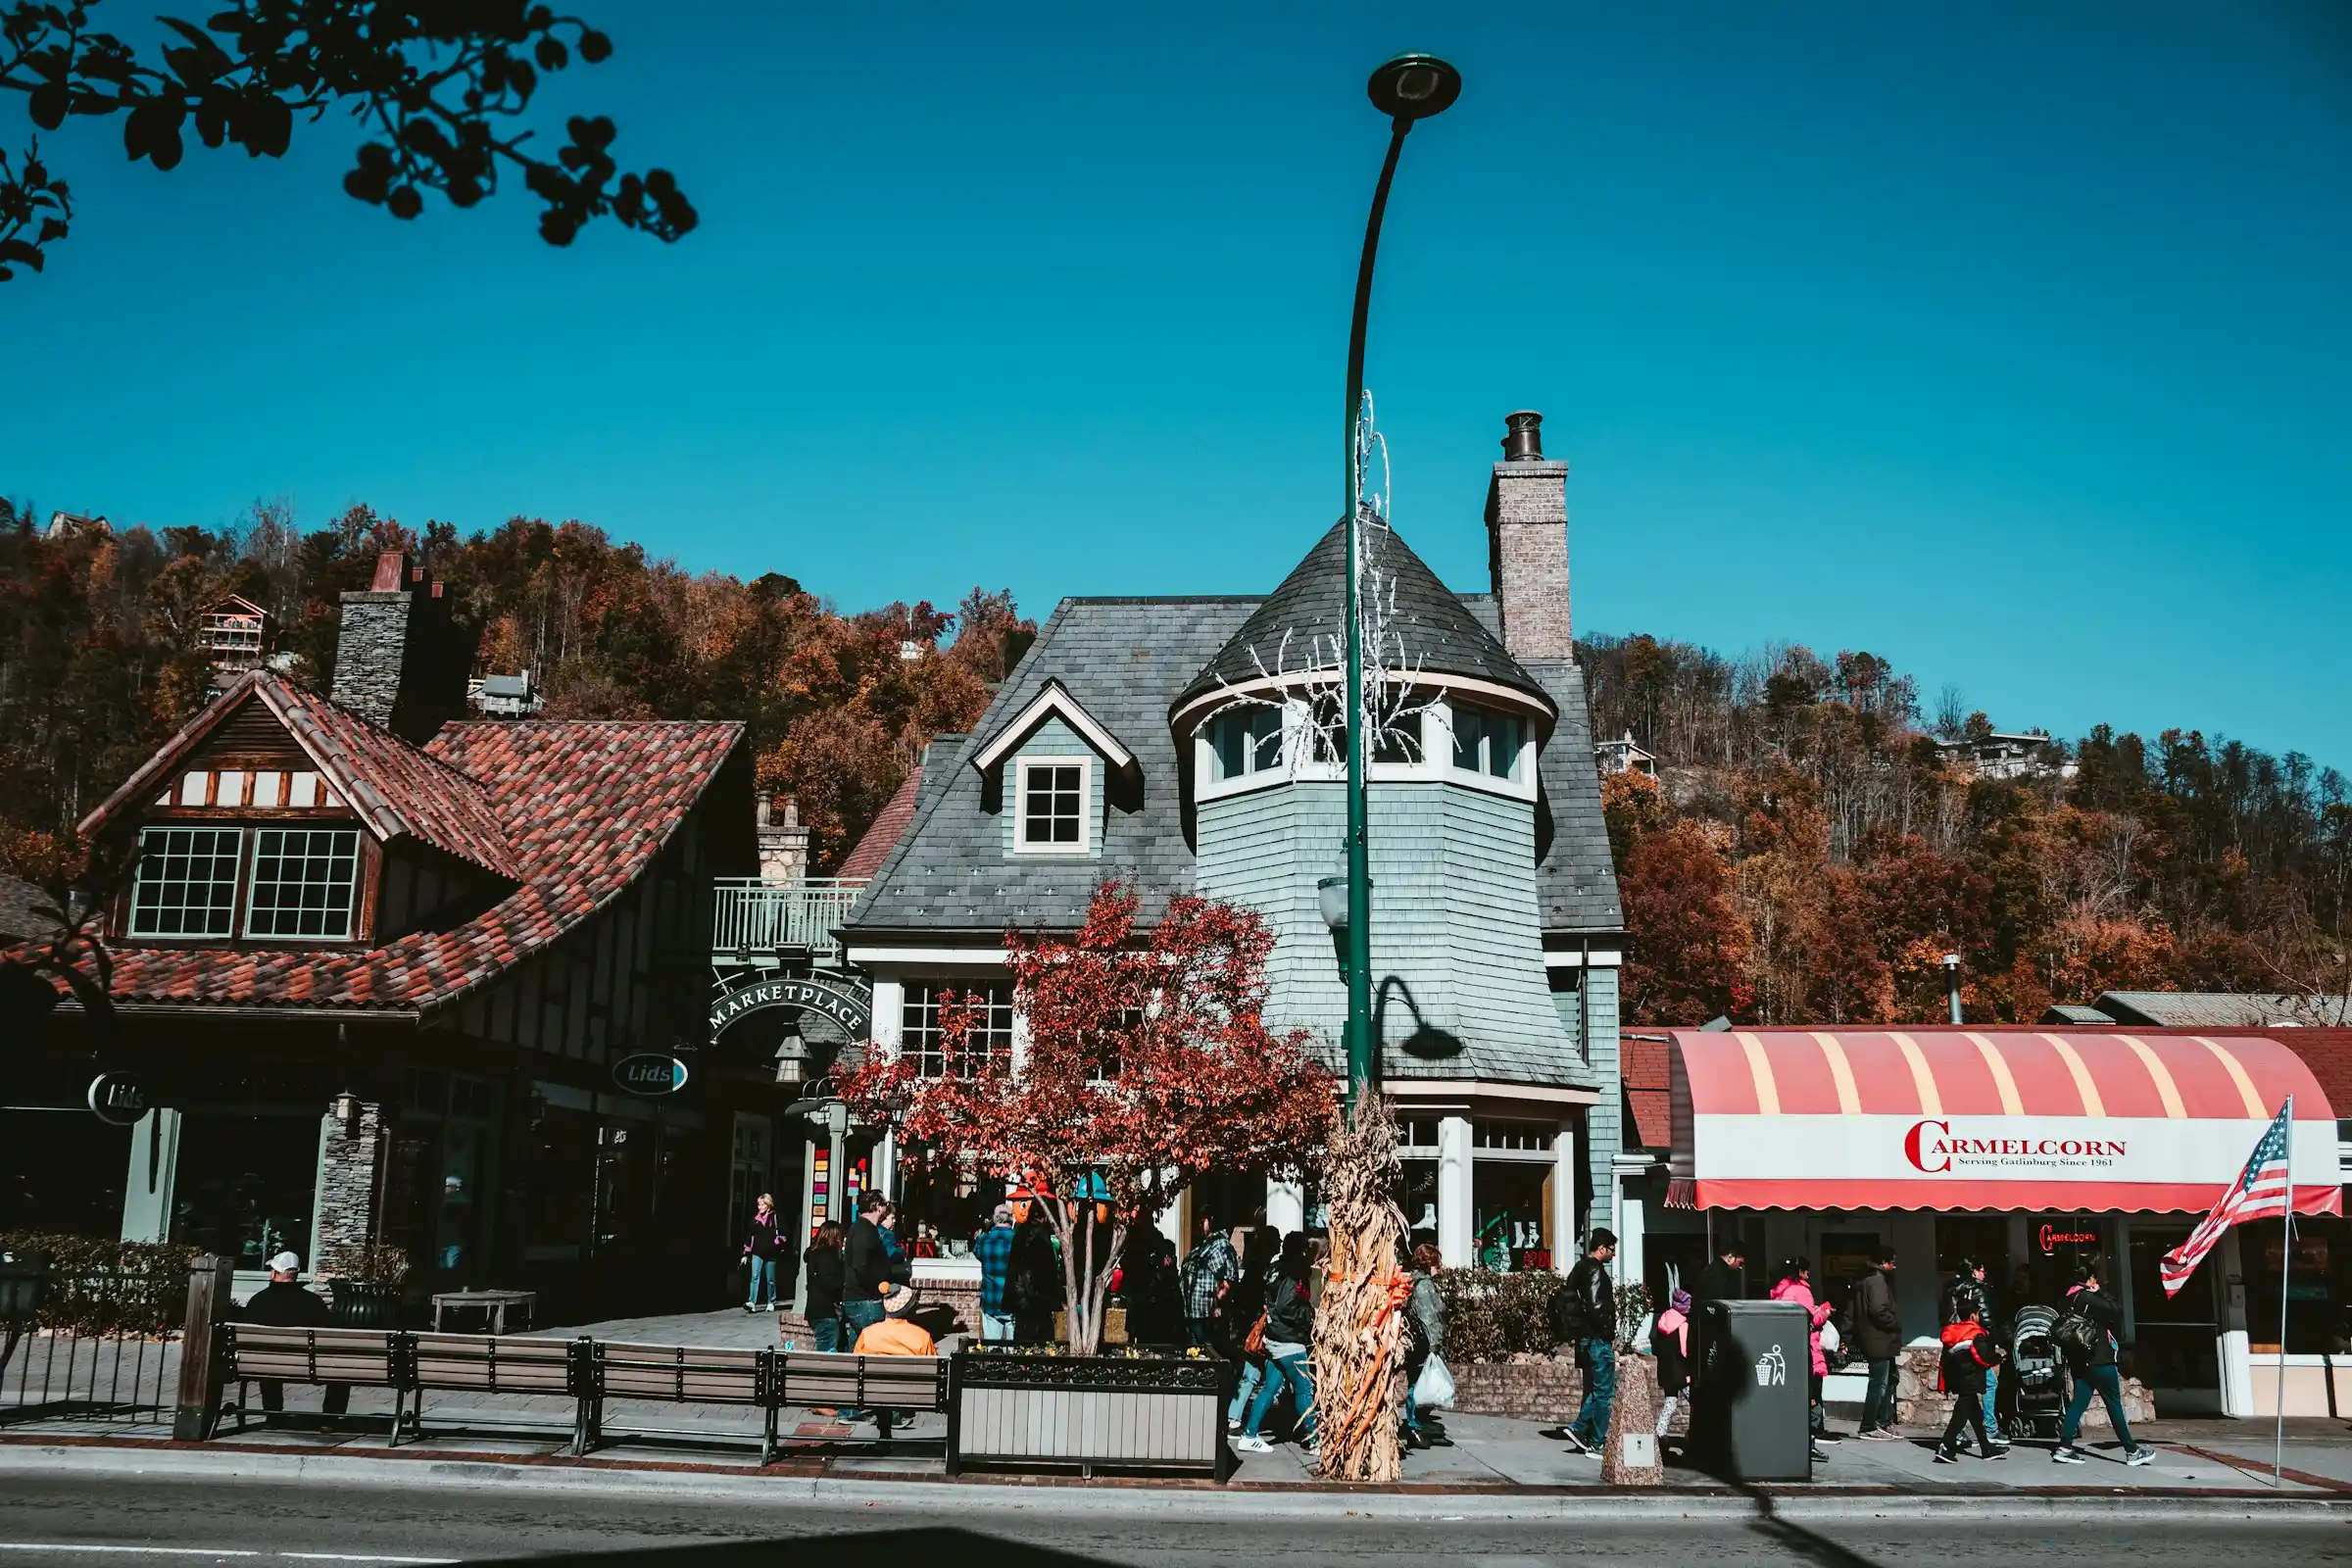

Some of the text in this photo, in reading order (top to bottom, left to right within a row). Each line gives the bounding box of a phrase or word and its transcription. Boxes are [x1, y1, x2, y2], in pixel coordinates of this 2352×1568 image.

[709, 985, 862, 1030] MARKETPLACE
[628, 1064, 670, 1082] Lids
[107, 1084, 144, 1108] Lids
[1904, 1120, 2128, 1173] CARMELCORN
[1958, 1157, 2114, 1168] Serving Gatlinburg Since 1961
[2039, 1224, 2095, 1251] CARMELCORN
